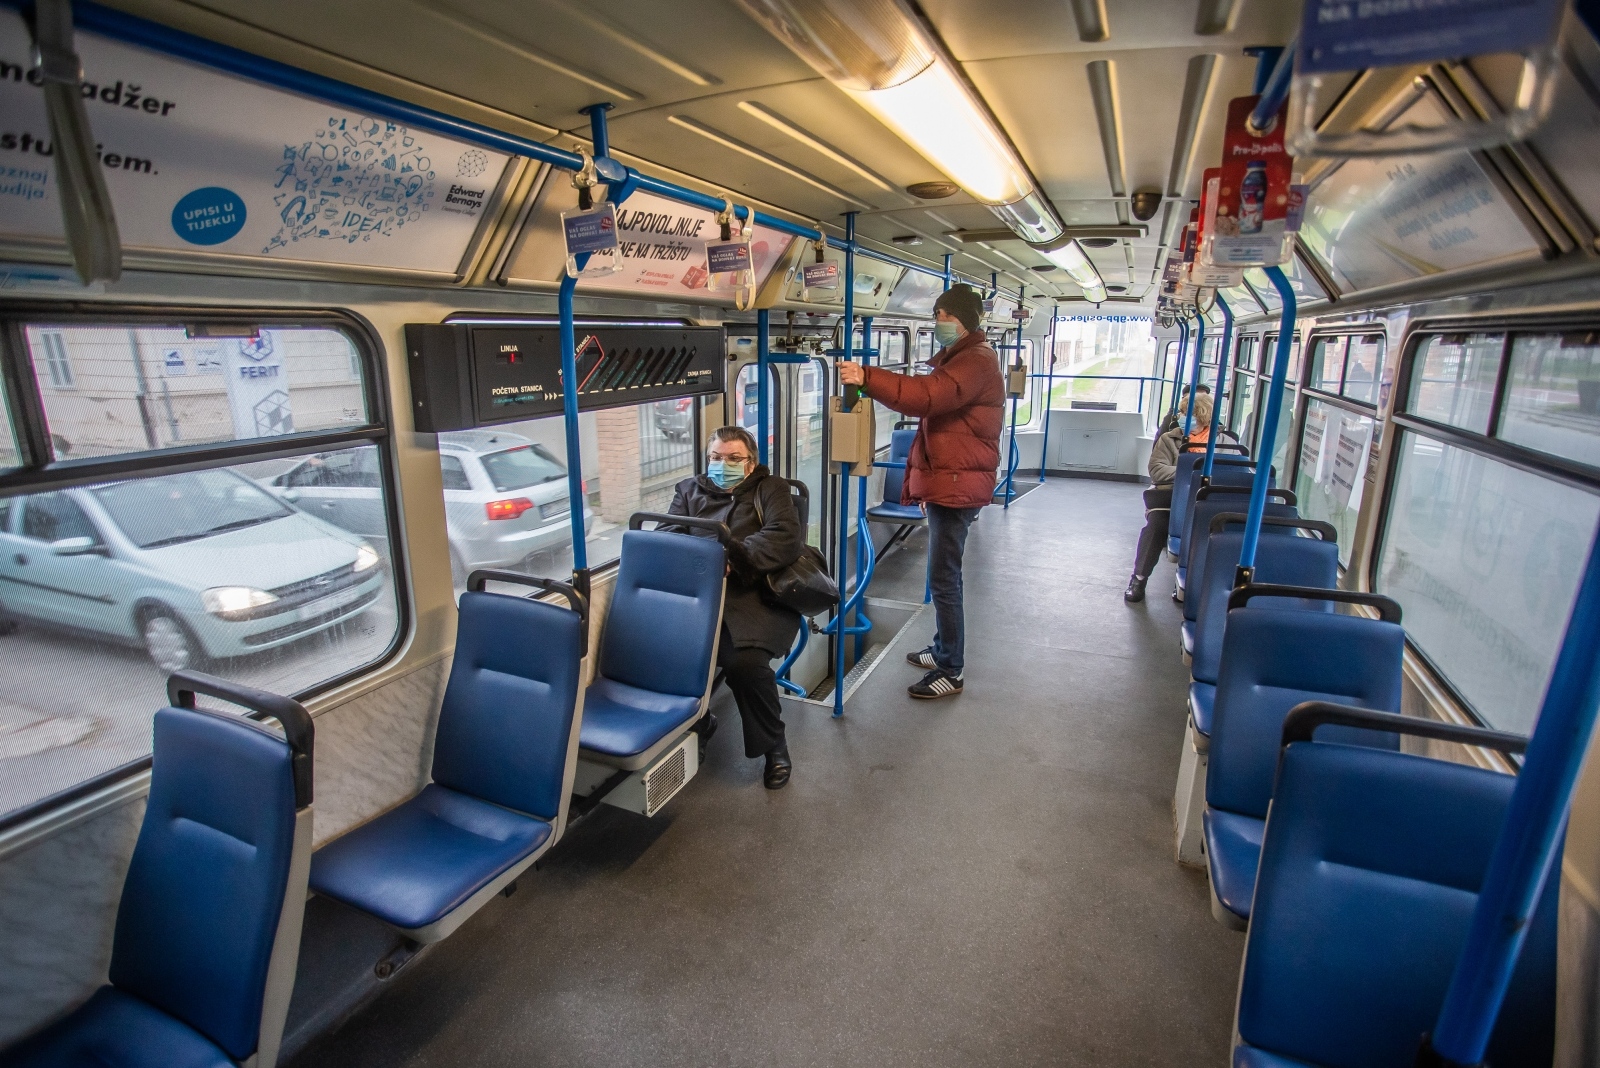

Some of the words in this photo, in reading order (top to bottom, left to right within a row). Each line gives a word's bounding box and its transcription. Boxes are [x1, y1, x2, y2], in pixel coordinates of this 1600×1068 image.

[0, 60, 176, 117] meadžer
[450, 184, 485, 199] Edward
[445, 194, 482, 209] Bernays
[183, 205, 220, 220] UPISI
[223, 202, 234, 212] U
[186, 213, 236, 231] TIJEKU!
[342, 210, 383, 233] IDEA
[633, 242, 651, 259] NA
[649, 240, 692, 261] TRŽIŠTU
[500, 345, 518, 353] LINIJA
[240, 365, 280, 378] FERIT
[492, 386, 519, 396] POČETNA
[520, 384, 543, 393] STANICA
